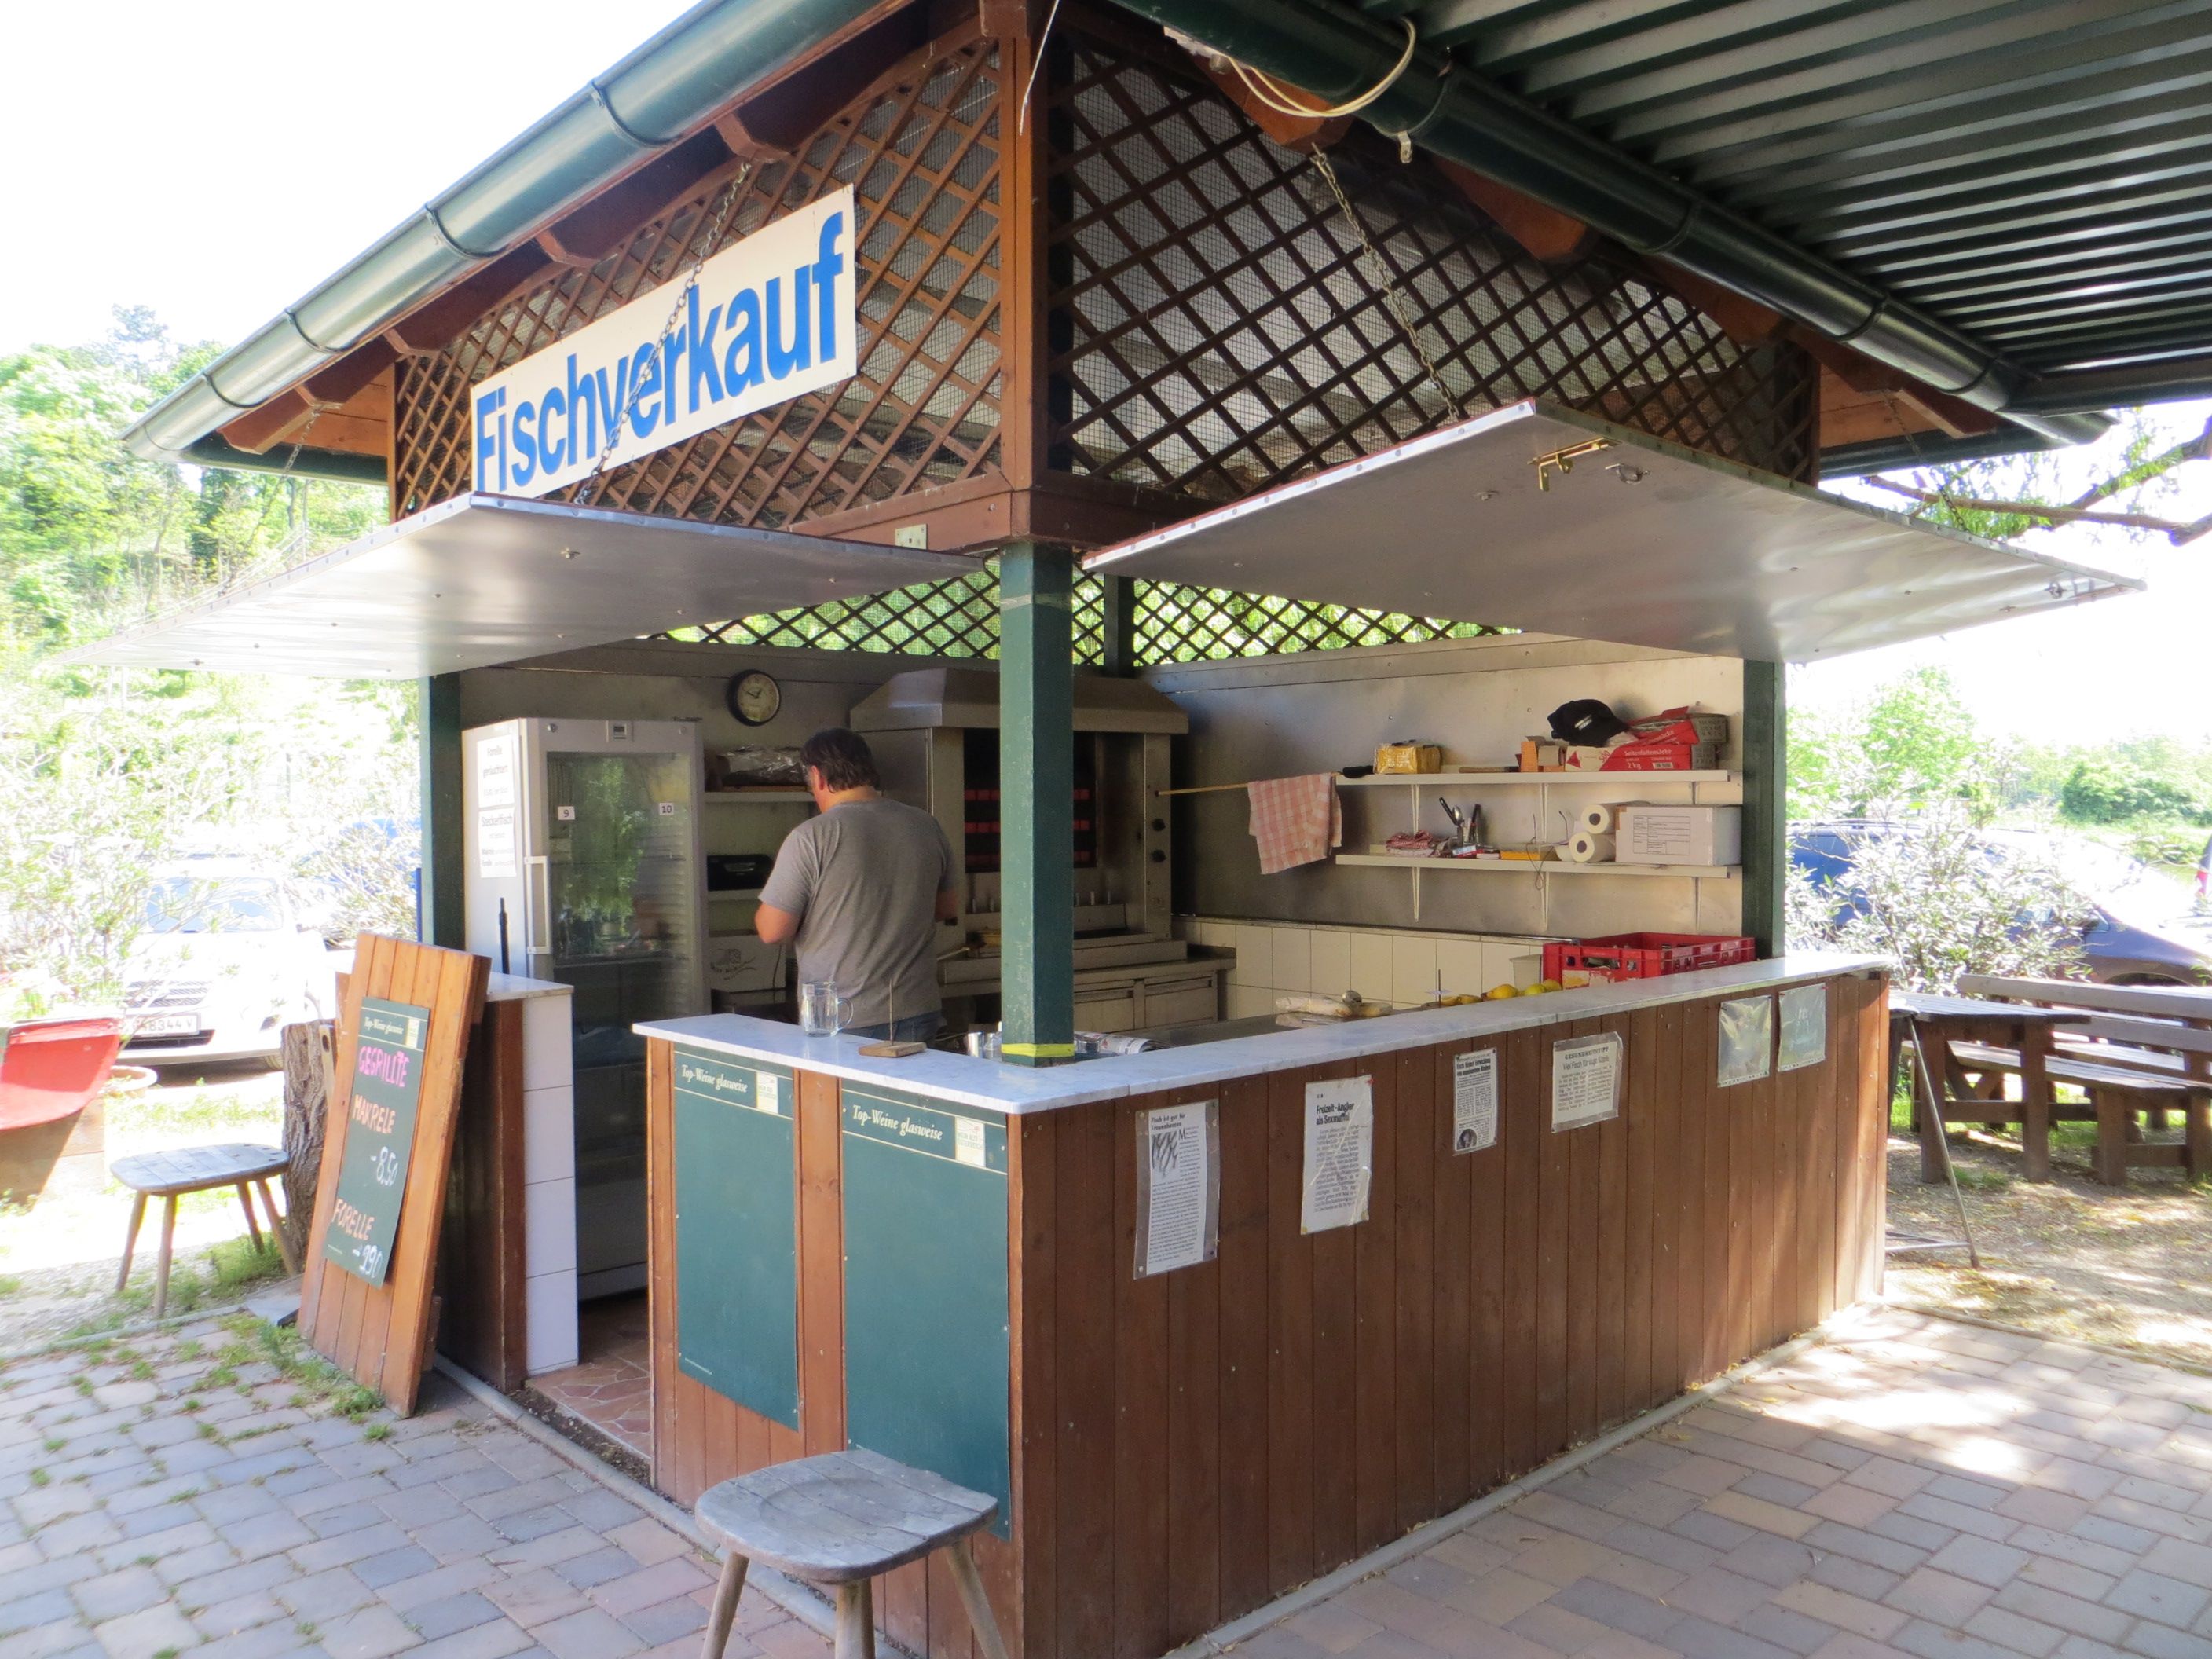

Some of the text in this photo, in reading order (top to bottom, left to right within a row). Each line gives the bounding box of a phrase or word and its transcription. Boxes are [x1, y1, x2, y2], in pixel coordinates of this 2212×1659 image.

[476, 211, 844, 493] Fischverkauf
[359, 1046, 410, 1088] GEGRILLTE
[681, 1064, 749, 1093] Top-Weine glasweise
[352, 1093, 396, 1133] MAKRELE
[852, 1104, 943, 1141] Top-Weine glasweise
[1151, 1115, 1162, 1123] Fisch
[331, 1198, 375, 1240] FORELLE
